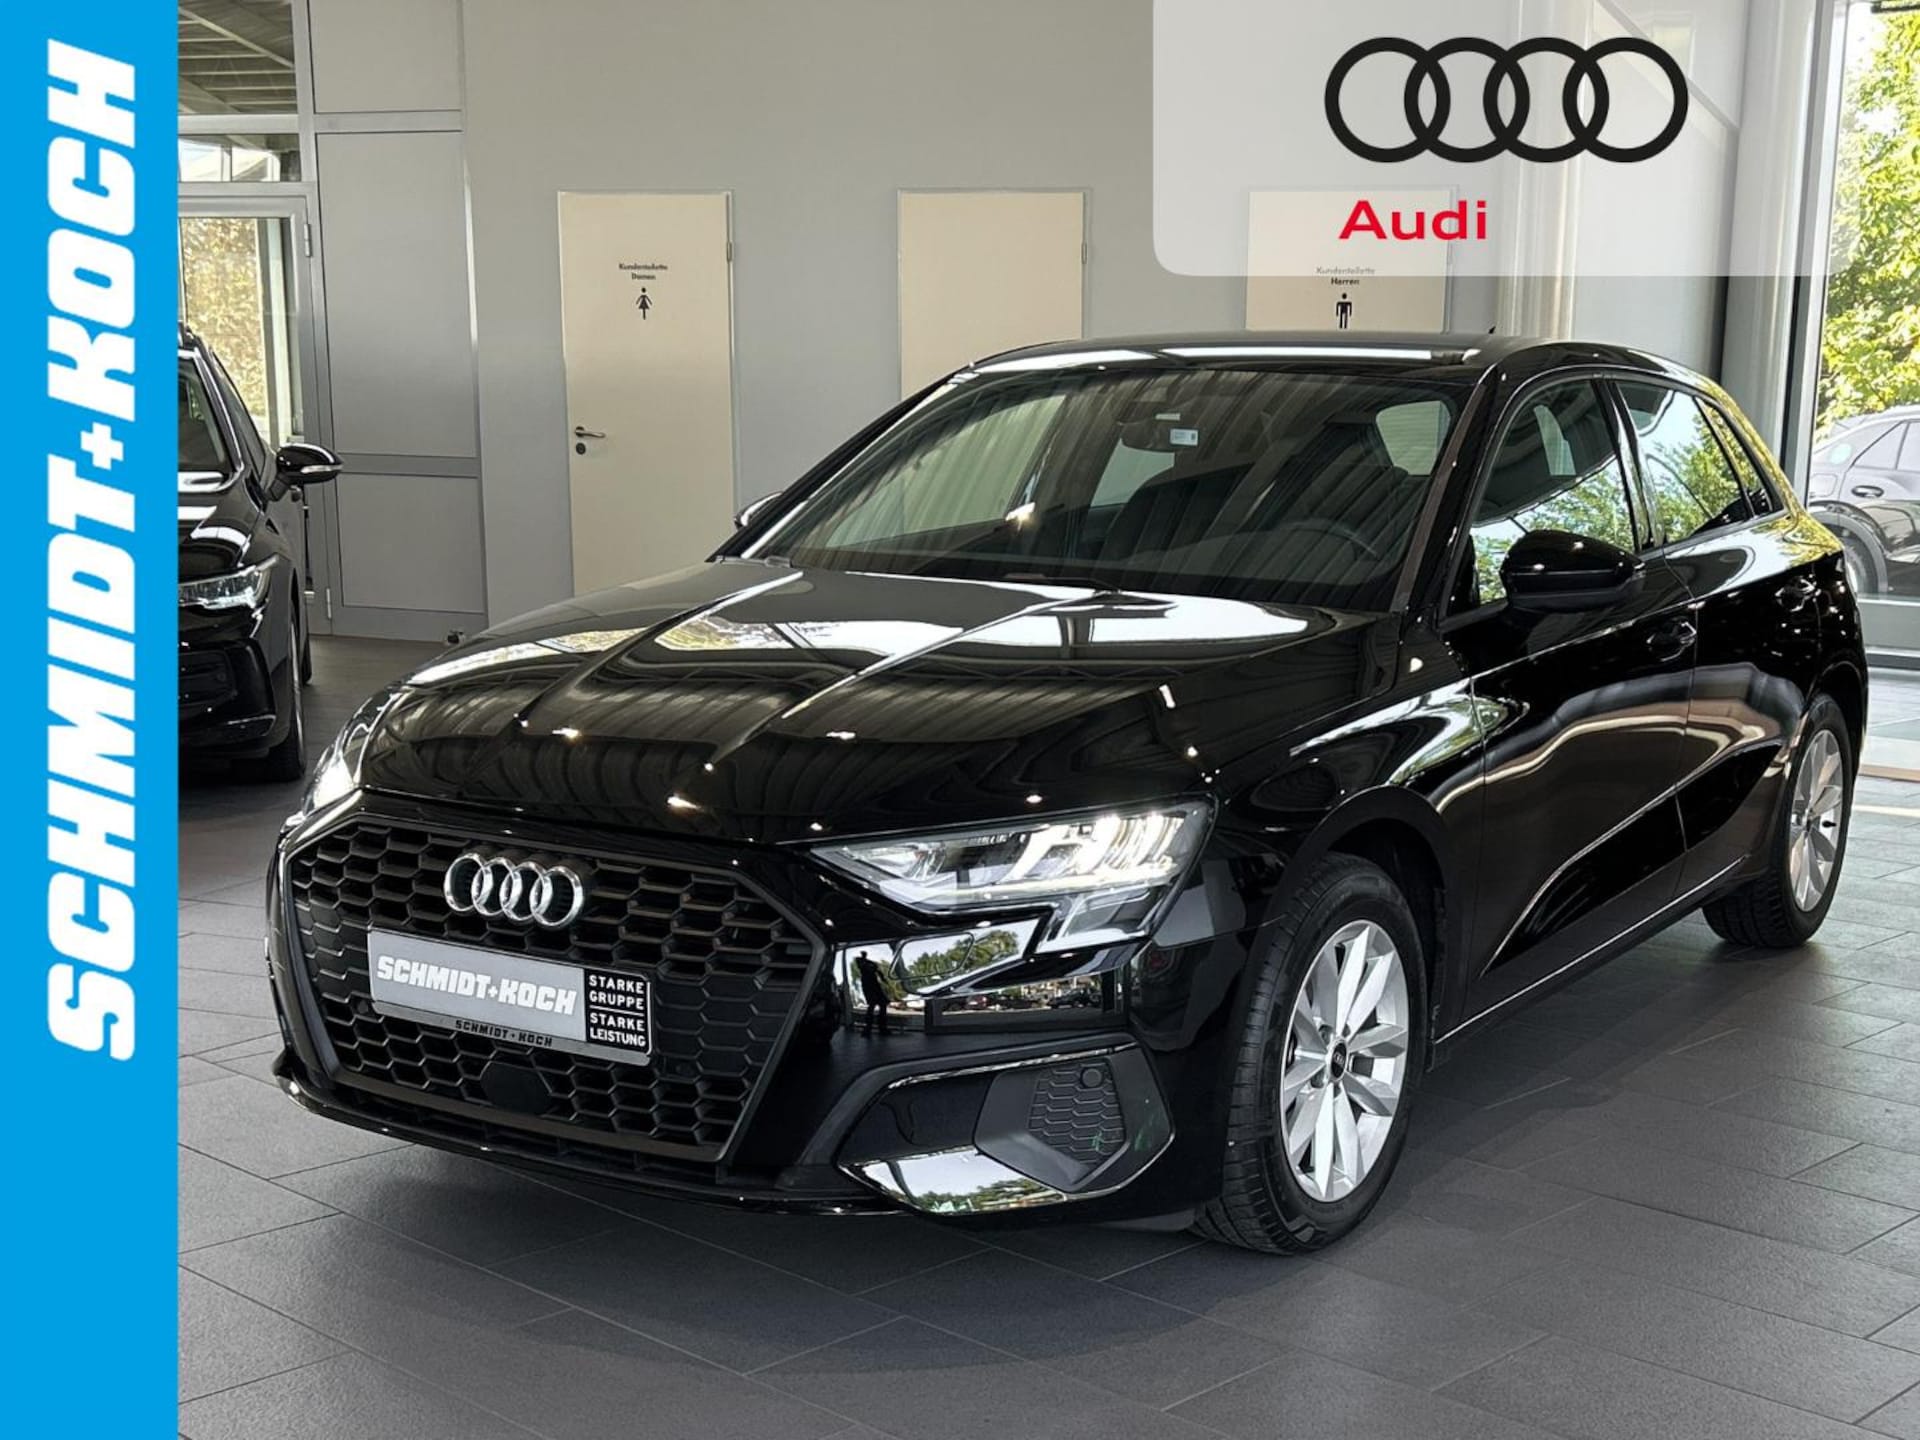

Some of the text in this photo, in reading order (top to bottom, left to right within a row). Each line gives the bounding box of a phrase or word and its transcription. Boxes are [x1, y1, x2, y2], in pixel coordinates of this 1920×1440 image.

[1330, 276, 1360, 286] Herren
[376, 954, 578, 1016] SCHMIDT+KOCH
[588, 974, 645, 995] STARKE
[588, 990, 645, 1011] GRUPPE
[589, 1011, 646, 1032] STARKE
[589, 1027, 647, 1048] LEISTUNG
